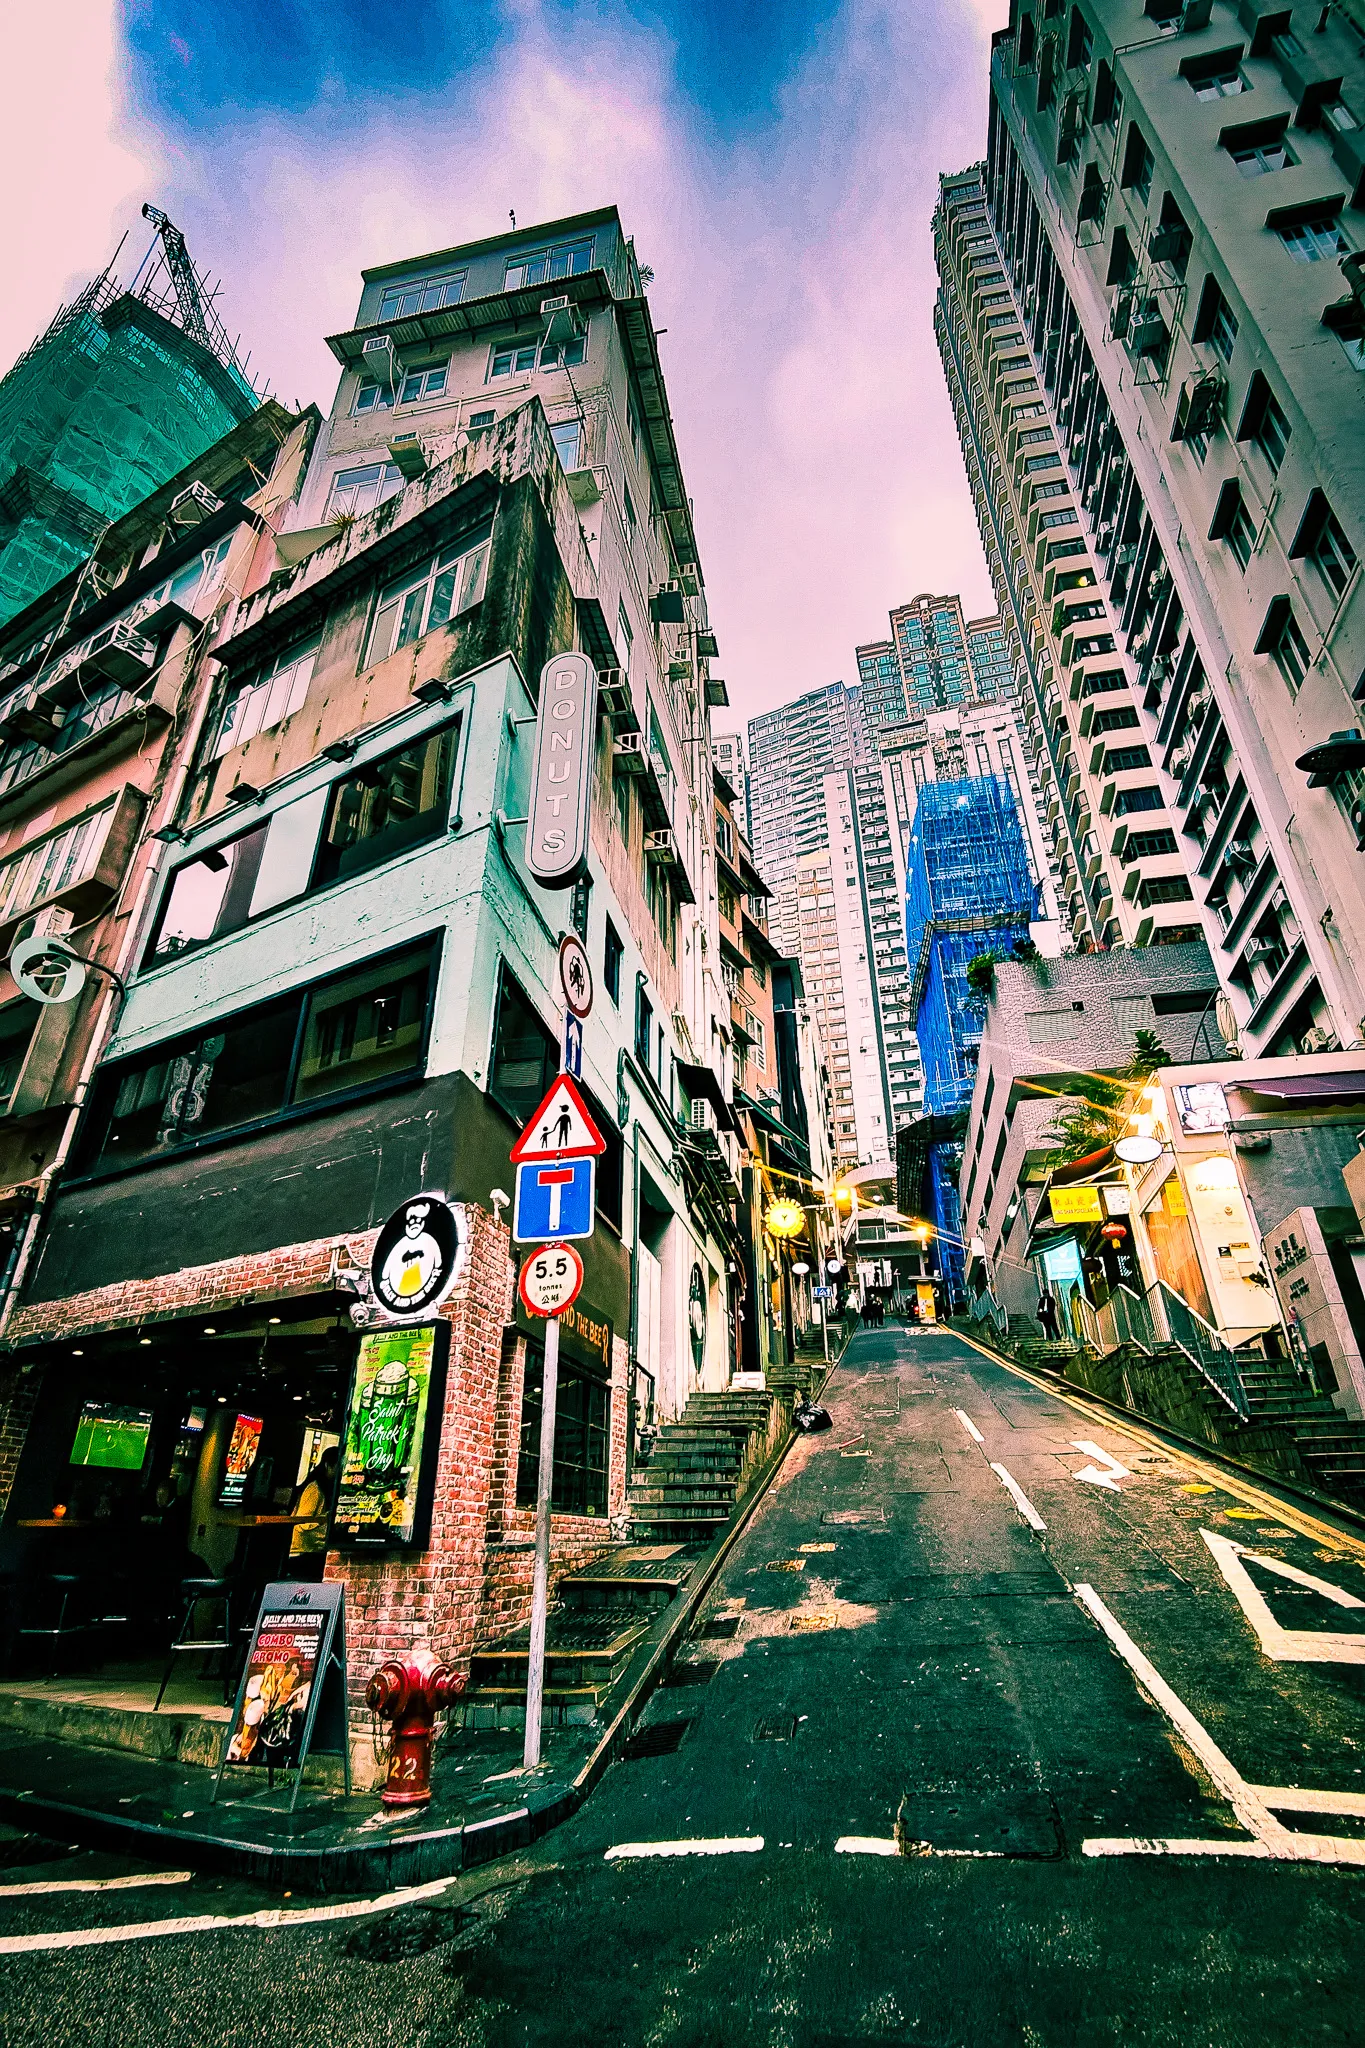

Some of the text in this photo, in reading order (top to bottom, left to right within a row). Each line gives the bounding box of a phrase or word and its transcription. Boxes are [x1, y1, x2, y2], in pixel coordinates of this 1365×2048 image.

[541, 670, 577, 854] DONUTS
[535, 1257, 567, 1279] 5.5
[539, 1283, 563, 1291] tonnes
[577, 1311, 588, 1338] THE
[589, 1323, 608, 1367] BEER
[369, 1397, 405, 1421] Saint
[361, 1420, 409, 1444] Patrick's
[366, 1447, 394, 1471] Day
[257, 1634, 294, 1647] COMBO
[251, 1651, 291, 1664] PROMO
[390, 1756, 418, 1780] 22
